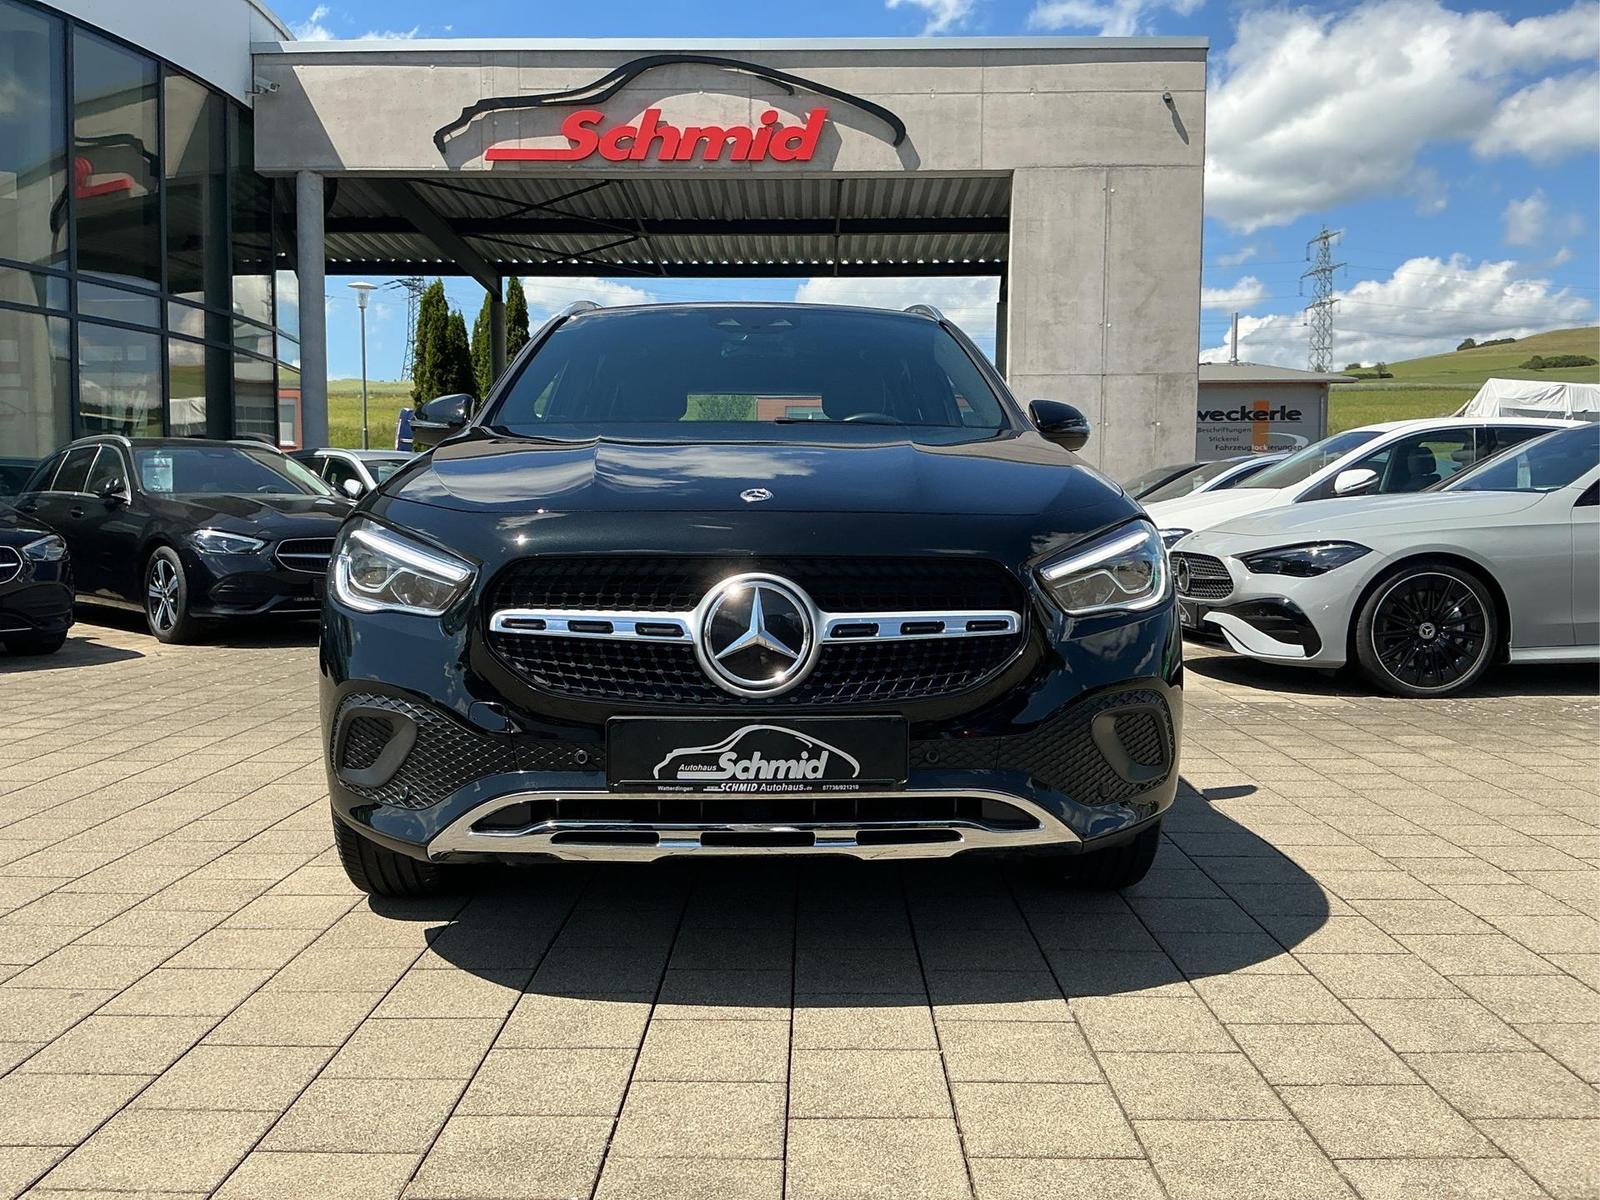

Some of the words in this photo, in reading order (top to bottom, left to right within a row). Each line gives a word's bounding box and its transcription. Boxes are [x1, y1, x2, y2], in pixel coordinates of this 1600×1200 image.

[485, 108, 828, 162] Schmid
[677, 750, 829, 780] Schmid
[678, 763, 717, 772] Autohaus
